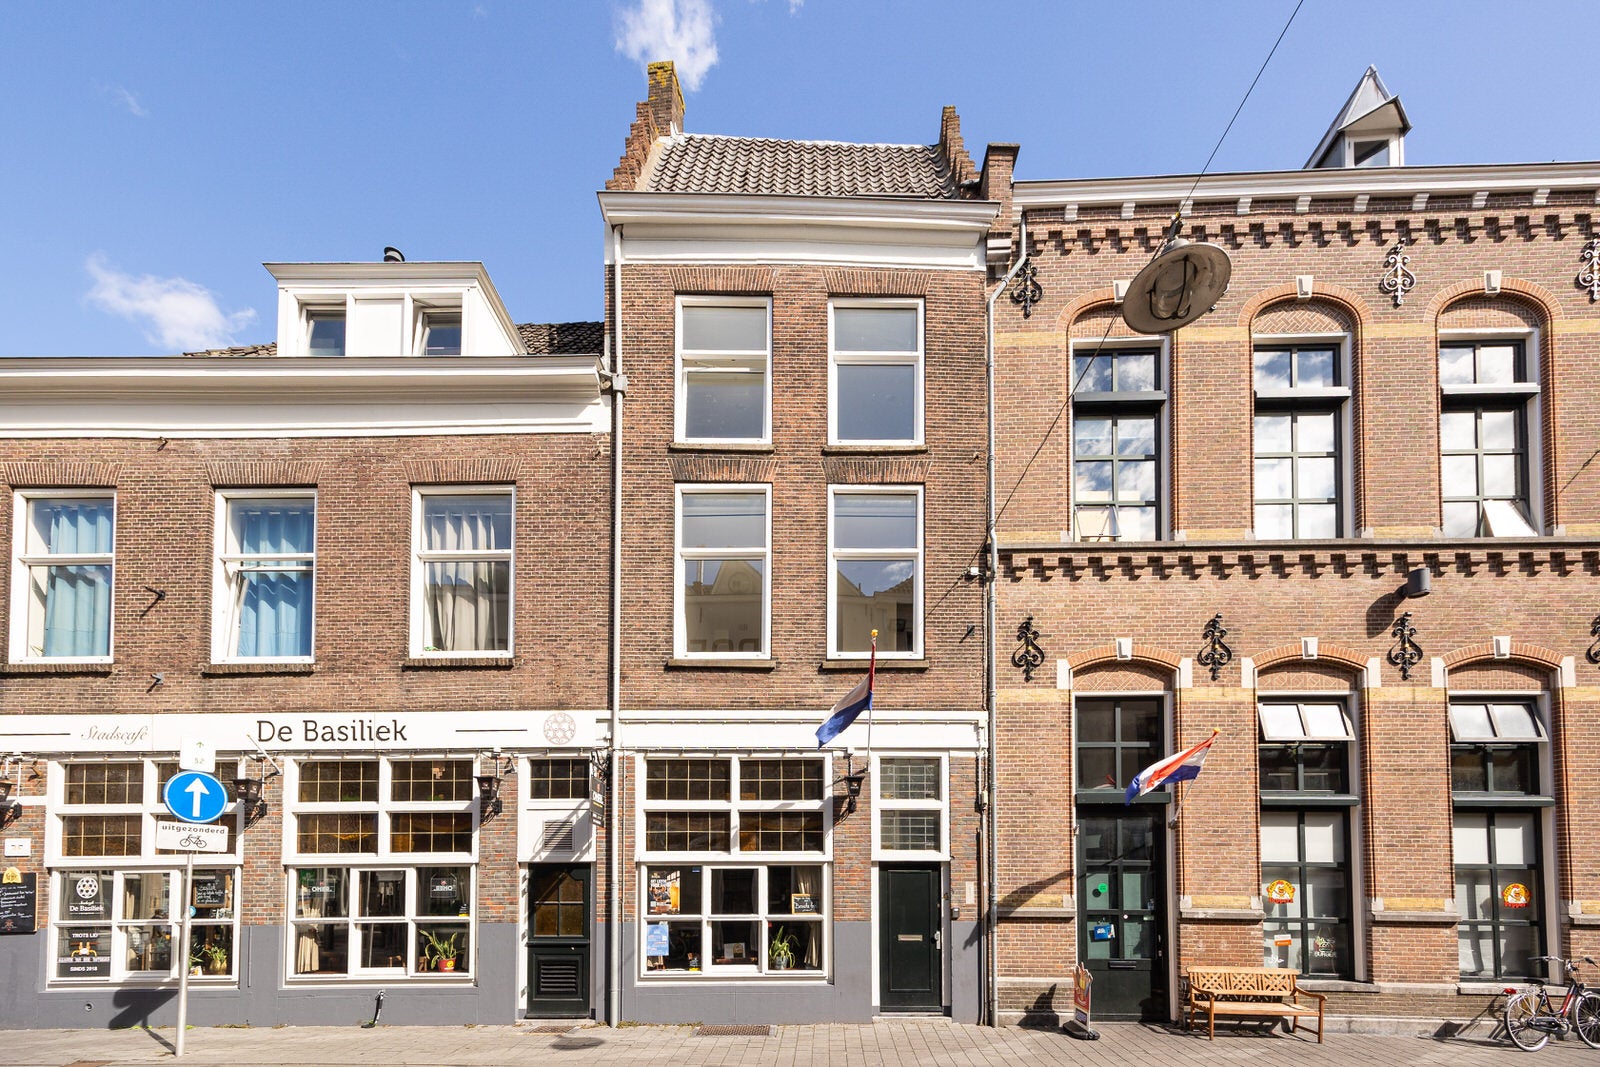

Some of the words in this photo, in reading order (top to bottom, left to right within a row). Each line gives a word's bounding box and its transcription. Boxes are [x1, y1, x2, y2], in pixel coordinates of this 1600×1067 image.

[257, 720, 293, 742] De
[303, 719, 407, 742] Basiliek
[161, 823, 226, 835] uitgezonderd
[80, 904, 105, 912] Basiliek
